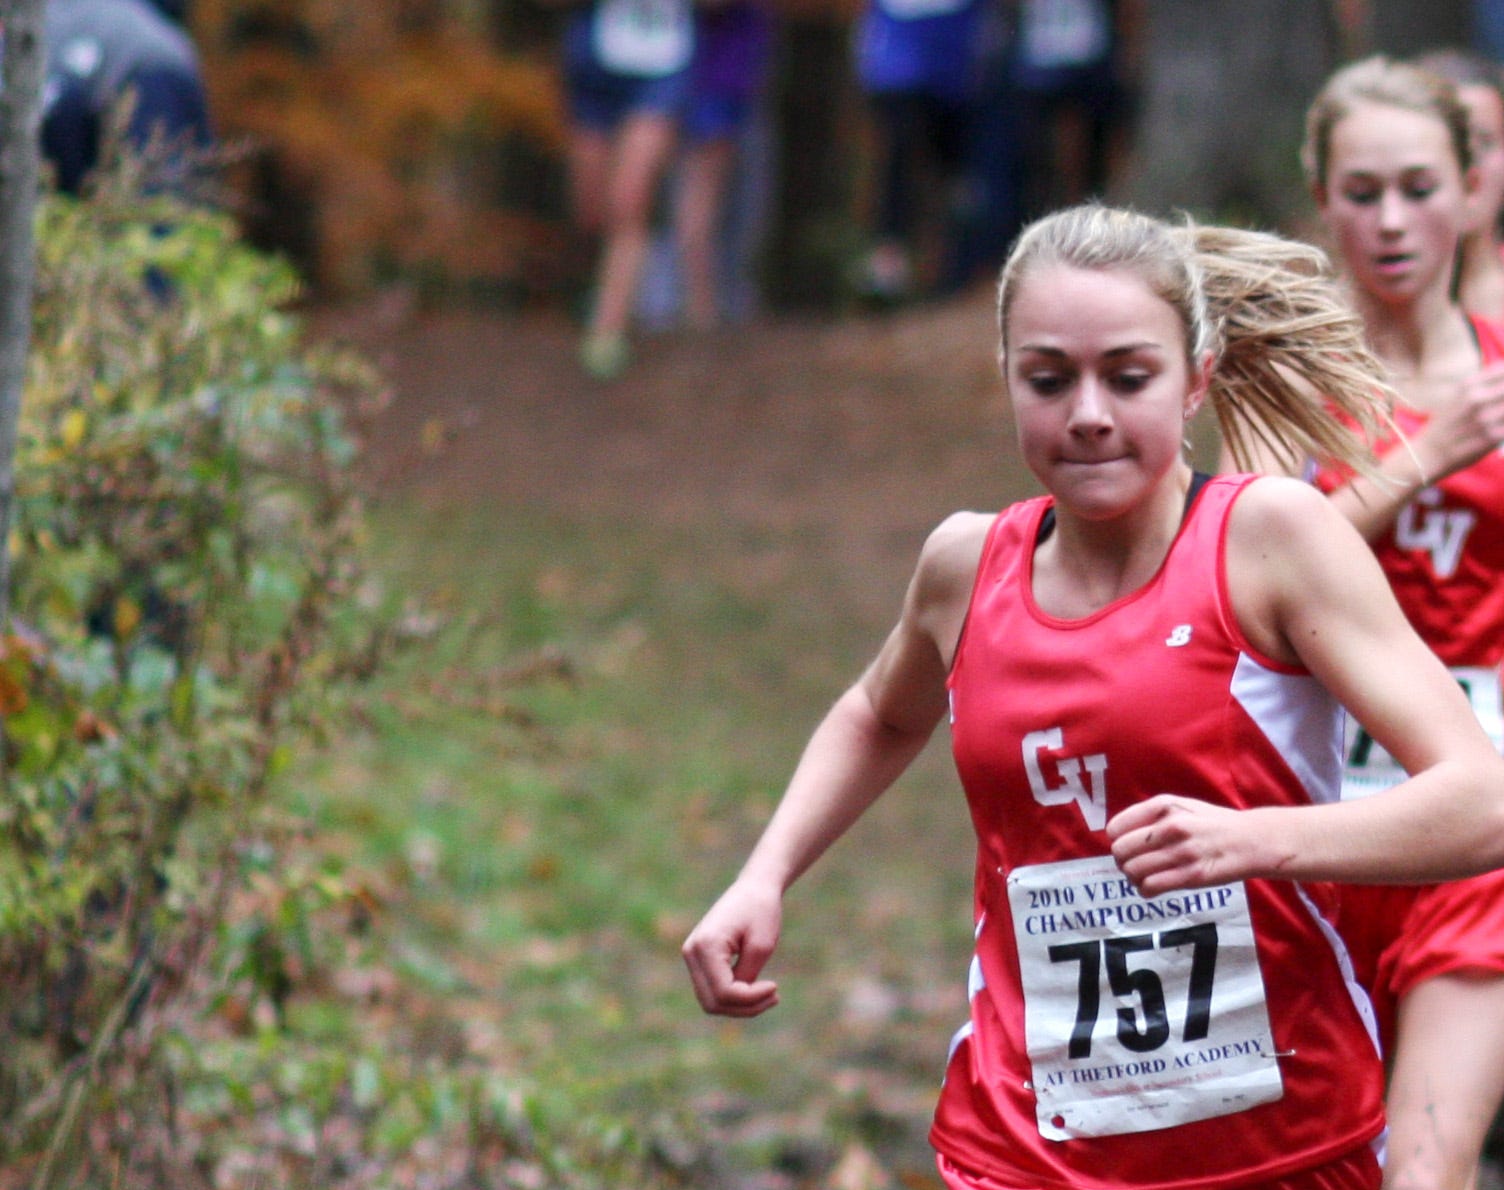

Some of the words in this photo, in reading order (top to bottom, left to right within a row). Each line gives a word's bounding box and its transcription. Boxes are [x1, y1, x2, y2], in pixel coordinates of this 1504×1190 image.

[1022, 726, 1108, 832] CV
[1025, 887, 1233, 935] CHAMPIONSHIP
[1027, 886, 1075, 909] 2010
[1048, 922, 1218, 1060] 757
[1044, 1070, 1064, 1087] AT
[1070, 1058, 1167, 1085] THETFORD
[1172, 1038, 1264, 1070] ACADEMY
